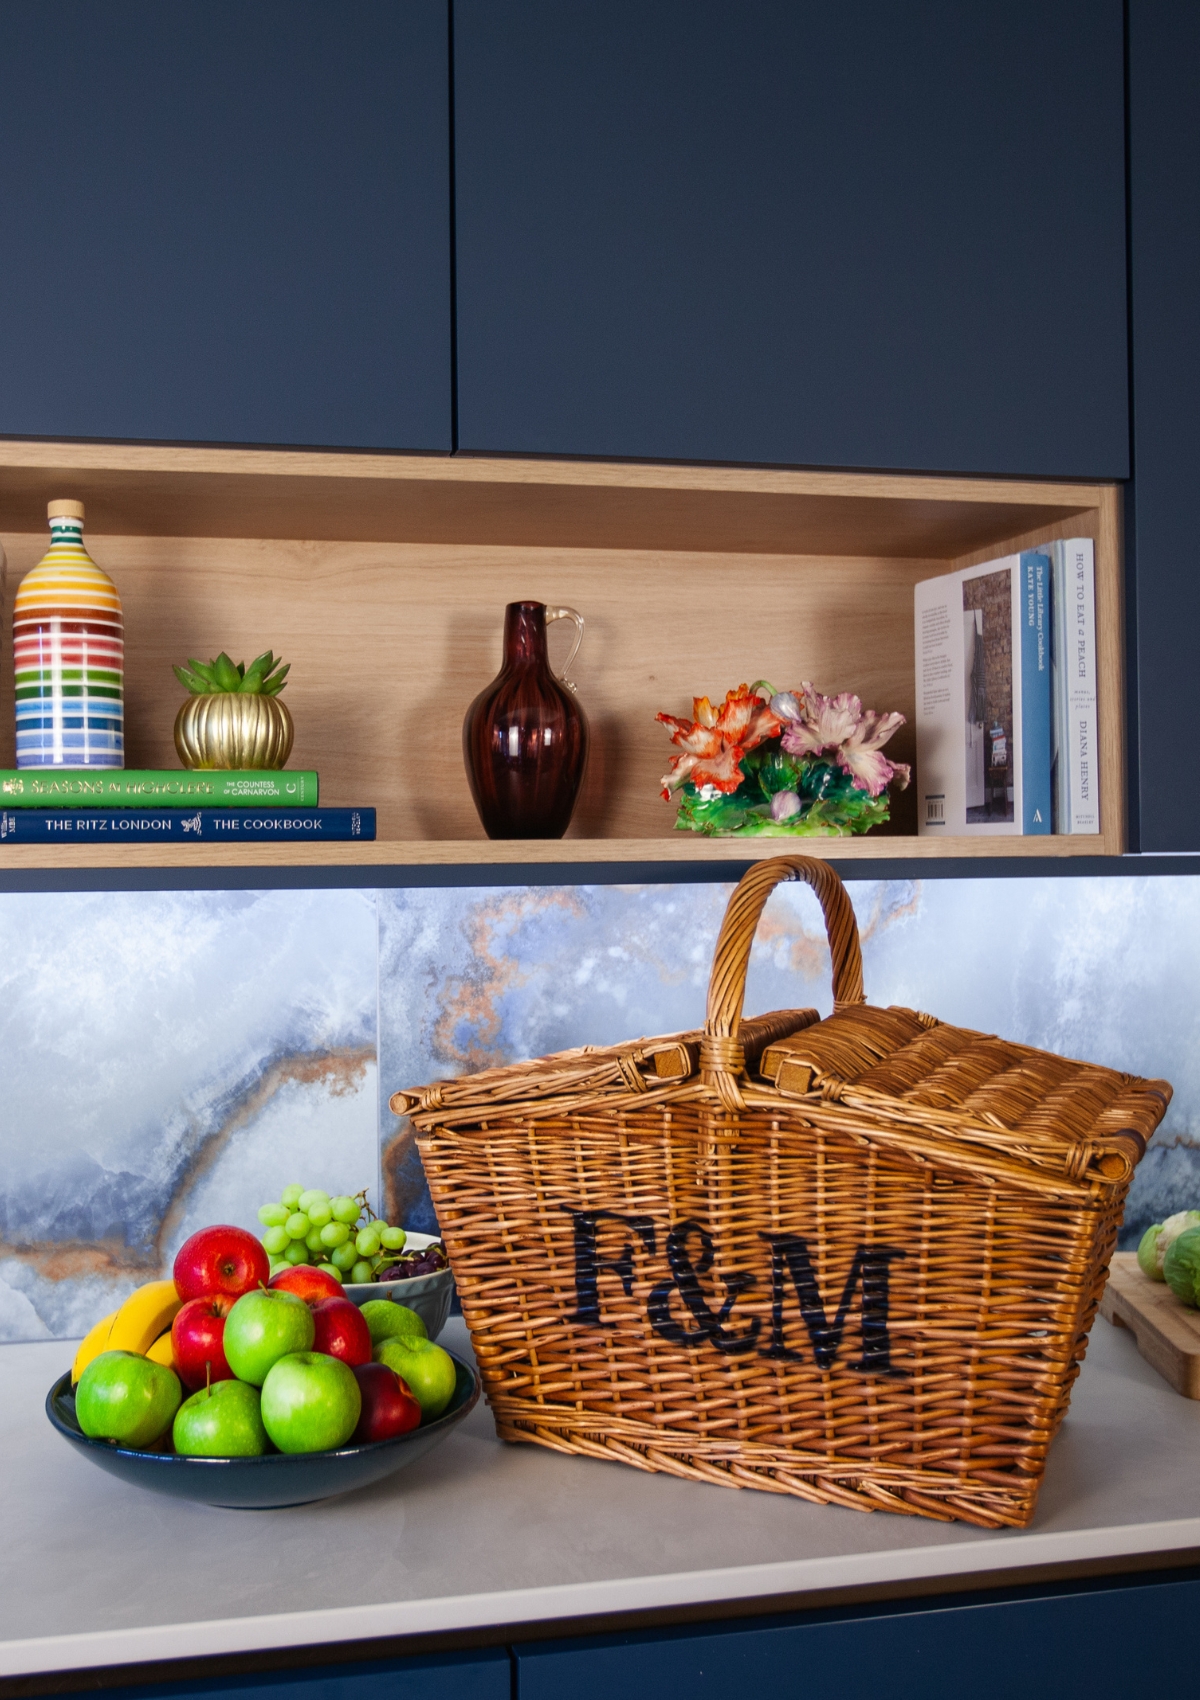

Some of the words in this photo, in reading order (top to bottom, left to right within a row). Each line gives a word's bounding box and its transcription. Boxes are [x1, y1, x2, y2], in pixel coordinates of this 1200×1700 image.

[1076, 553, 1084, 581] HOW
[1076, 585, 1085, 600] TO
[1027, 594, 1035, 627] YOUNG
[1036, 603, 1044, 631] Library
[1077, 604, 1085, 625] EAT
[1037, 633, 1045, 671] Cookbook
[1078, 640, 1086, 678] PEACH
[1079, 721, 1088, 757] DIANA
[31, 780, 104, 794] SEASONS
[126, 781, 215, 794] HIGHCLERE
[231, 788, 280, 796] CARNARVON
[236, 780, 275, 789] COUNTESS
[1081, 761, 1089, 801] HENRY
[45, 819, 73, 831] THE
[76, 819, 107, 831] RITZ
[111, 819, 172, 830] LONDON
[213, 819, 240, 830] THE
[243, 819, 323, 830] COOKBOOK
[560, 1204, 907, 1378] F&M
